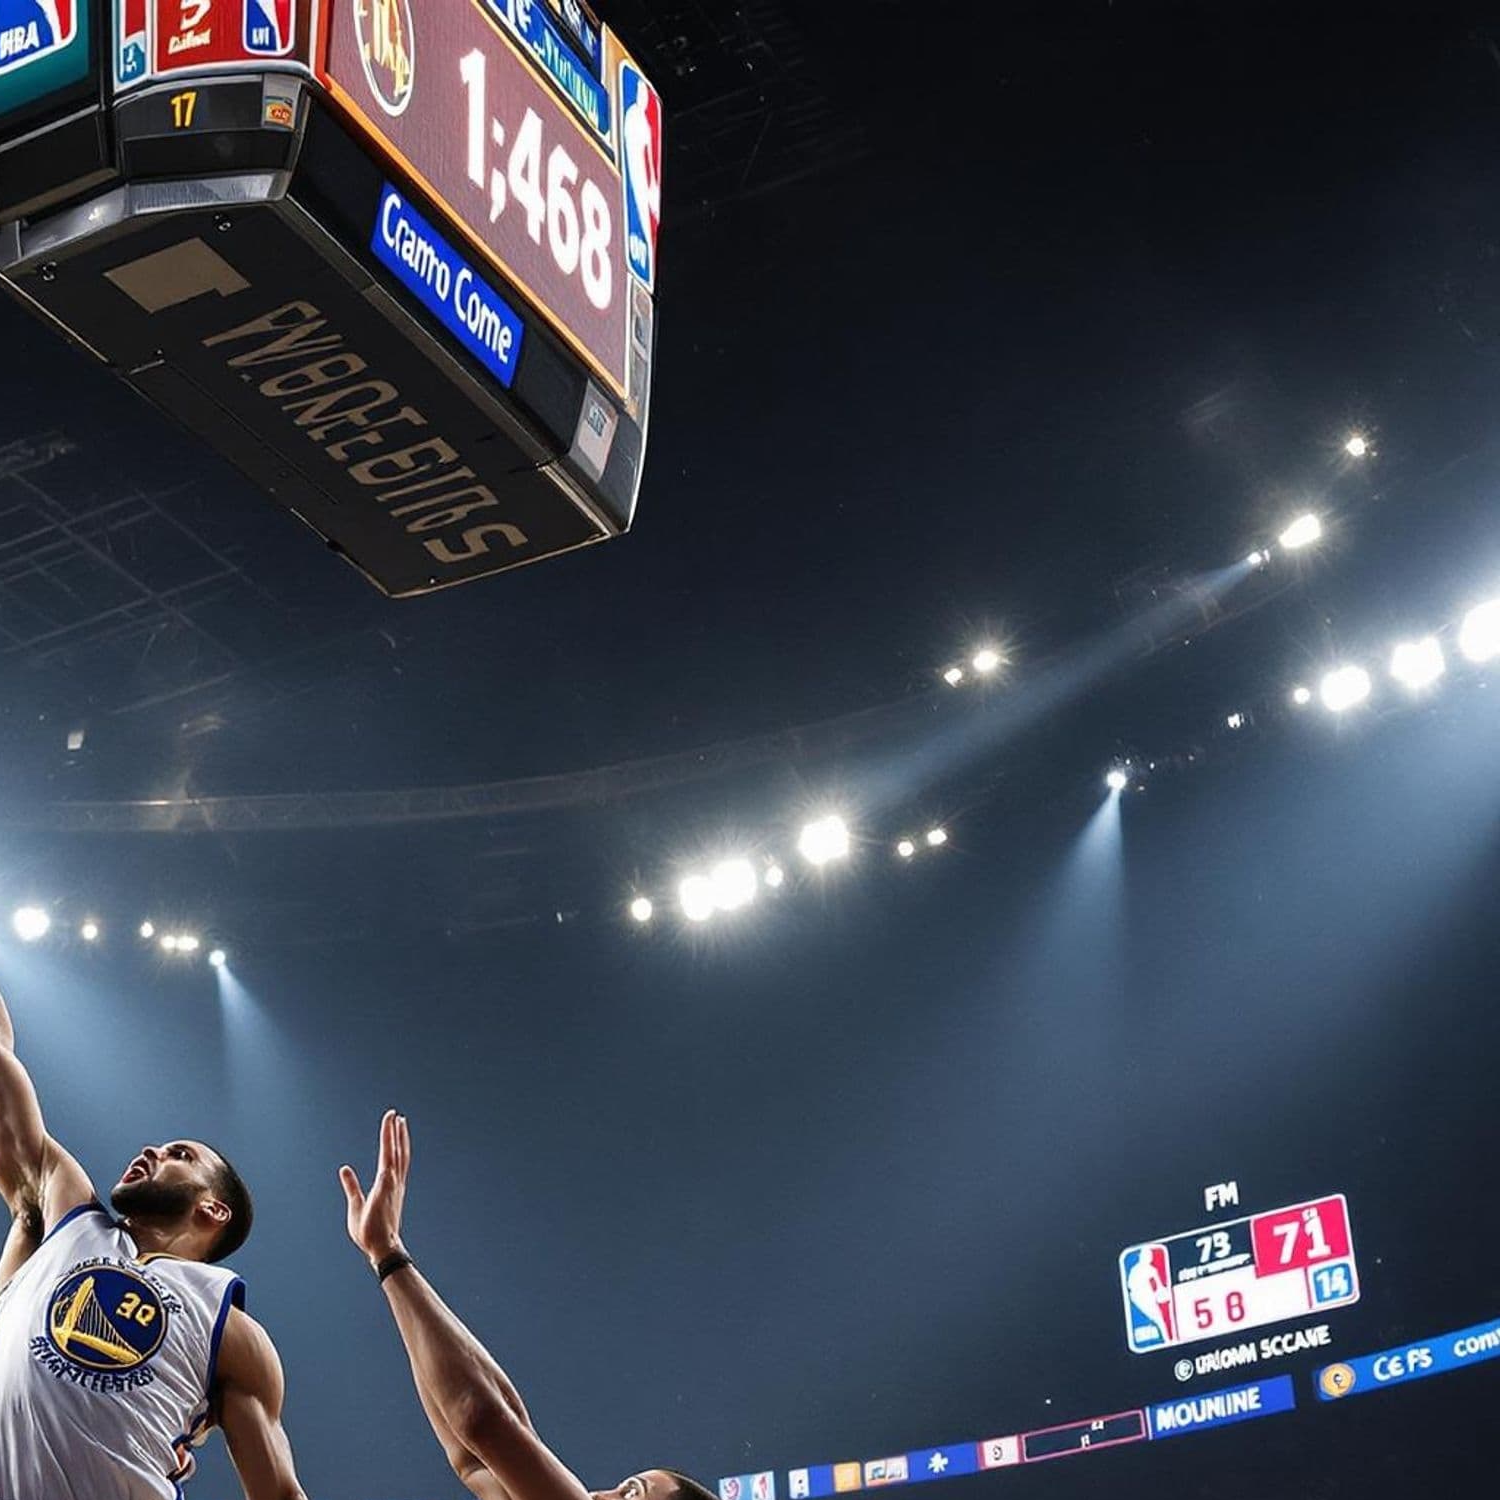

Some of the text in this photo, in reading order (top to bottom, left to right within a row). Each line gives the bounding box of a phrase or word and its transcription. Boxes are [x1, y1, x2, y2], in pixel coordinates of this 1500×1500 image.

[170, 91, 197, 128] 17
[453, 267, 514, 364] Come
[1204, 1181, 1239, 1212] FM
